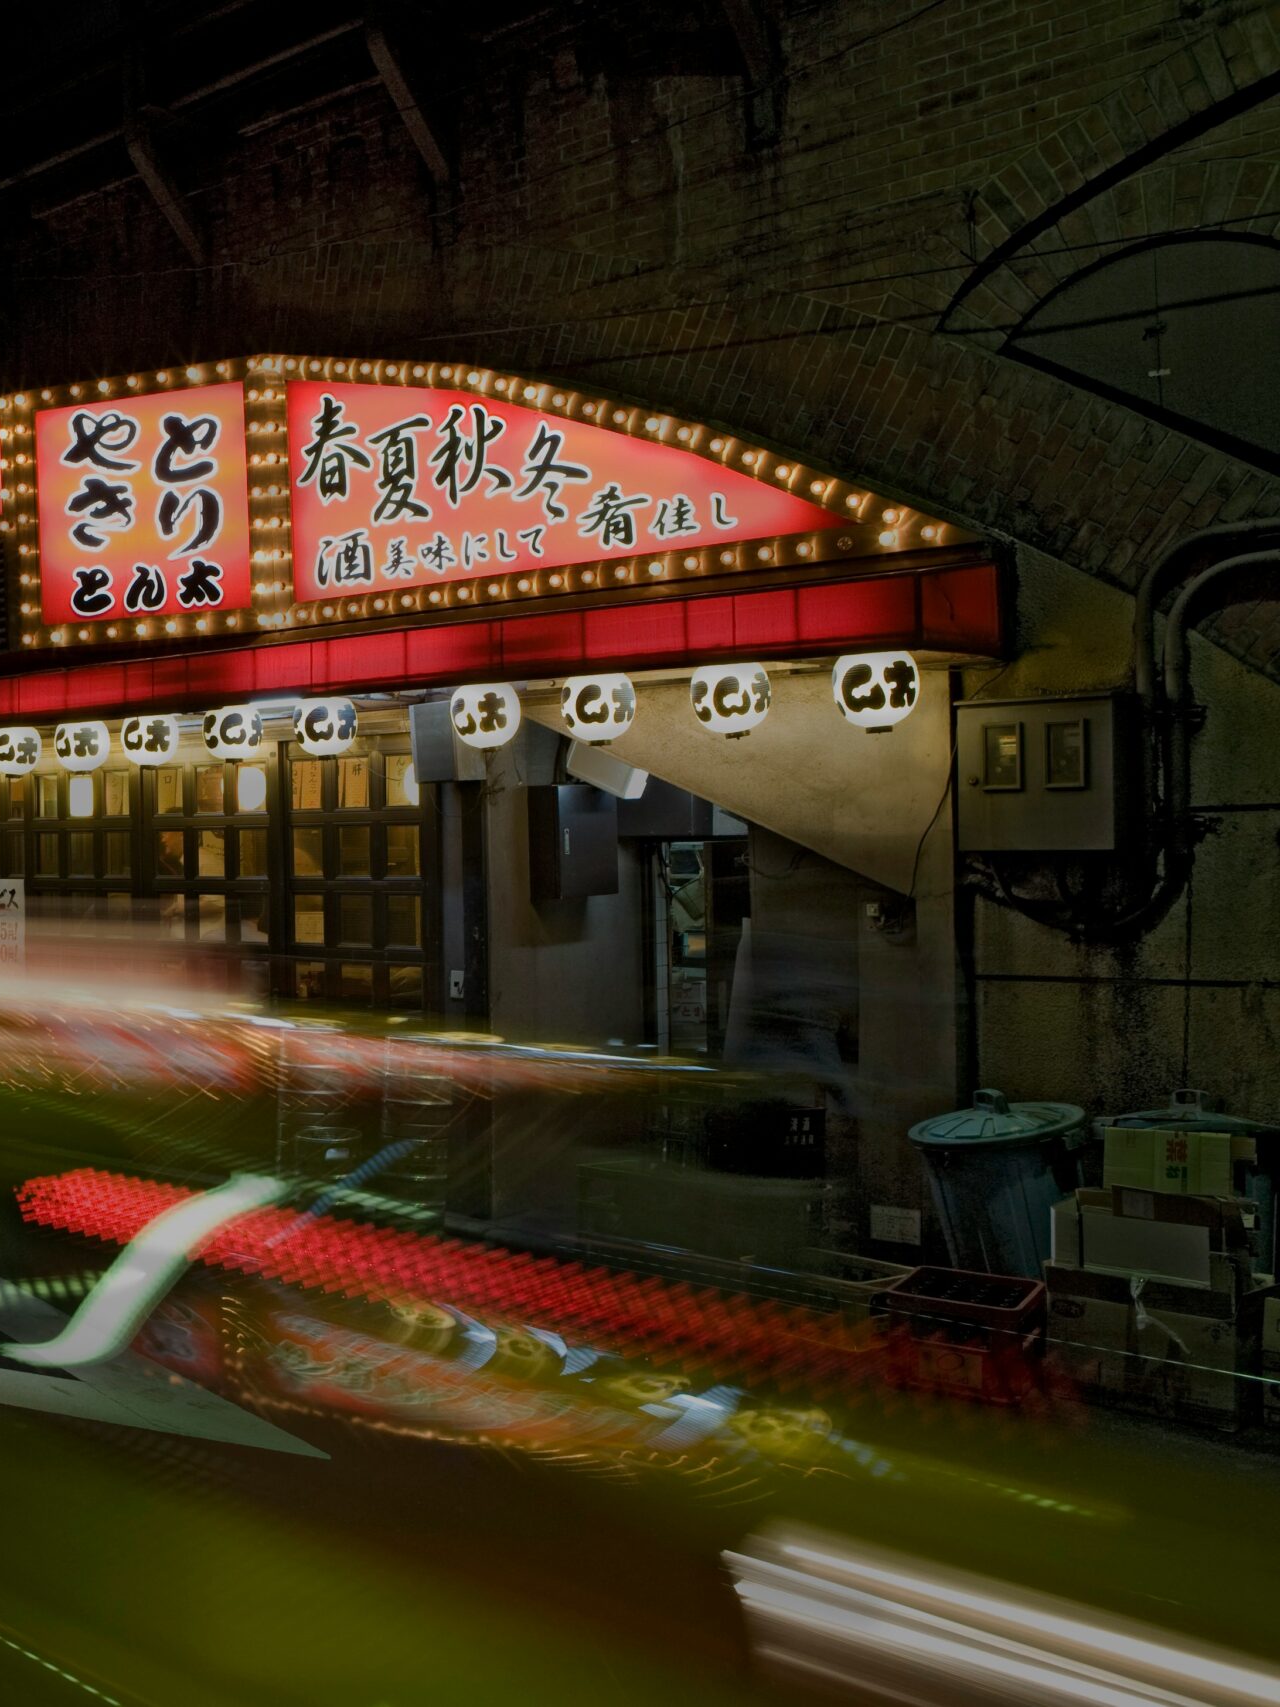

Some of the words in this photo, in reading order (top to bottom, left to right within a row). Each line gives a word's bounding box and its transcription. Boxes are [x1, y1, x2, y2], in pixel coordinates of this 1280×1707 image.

[61, 408, 142, 549] やき
[153, 412, 224, 560] とり
[298, 394, 590, 523] 春夏秋冬
[578, 485, 739, 548] 肴佳し
[316, 525, 546, 587] 酒美味にして
[70, 560, 225, 617] とん太
[833, 660, 917, 717] ん太
